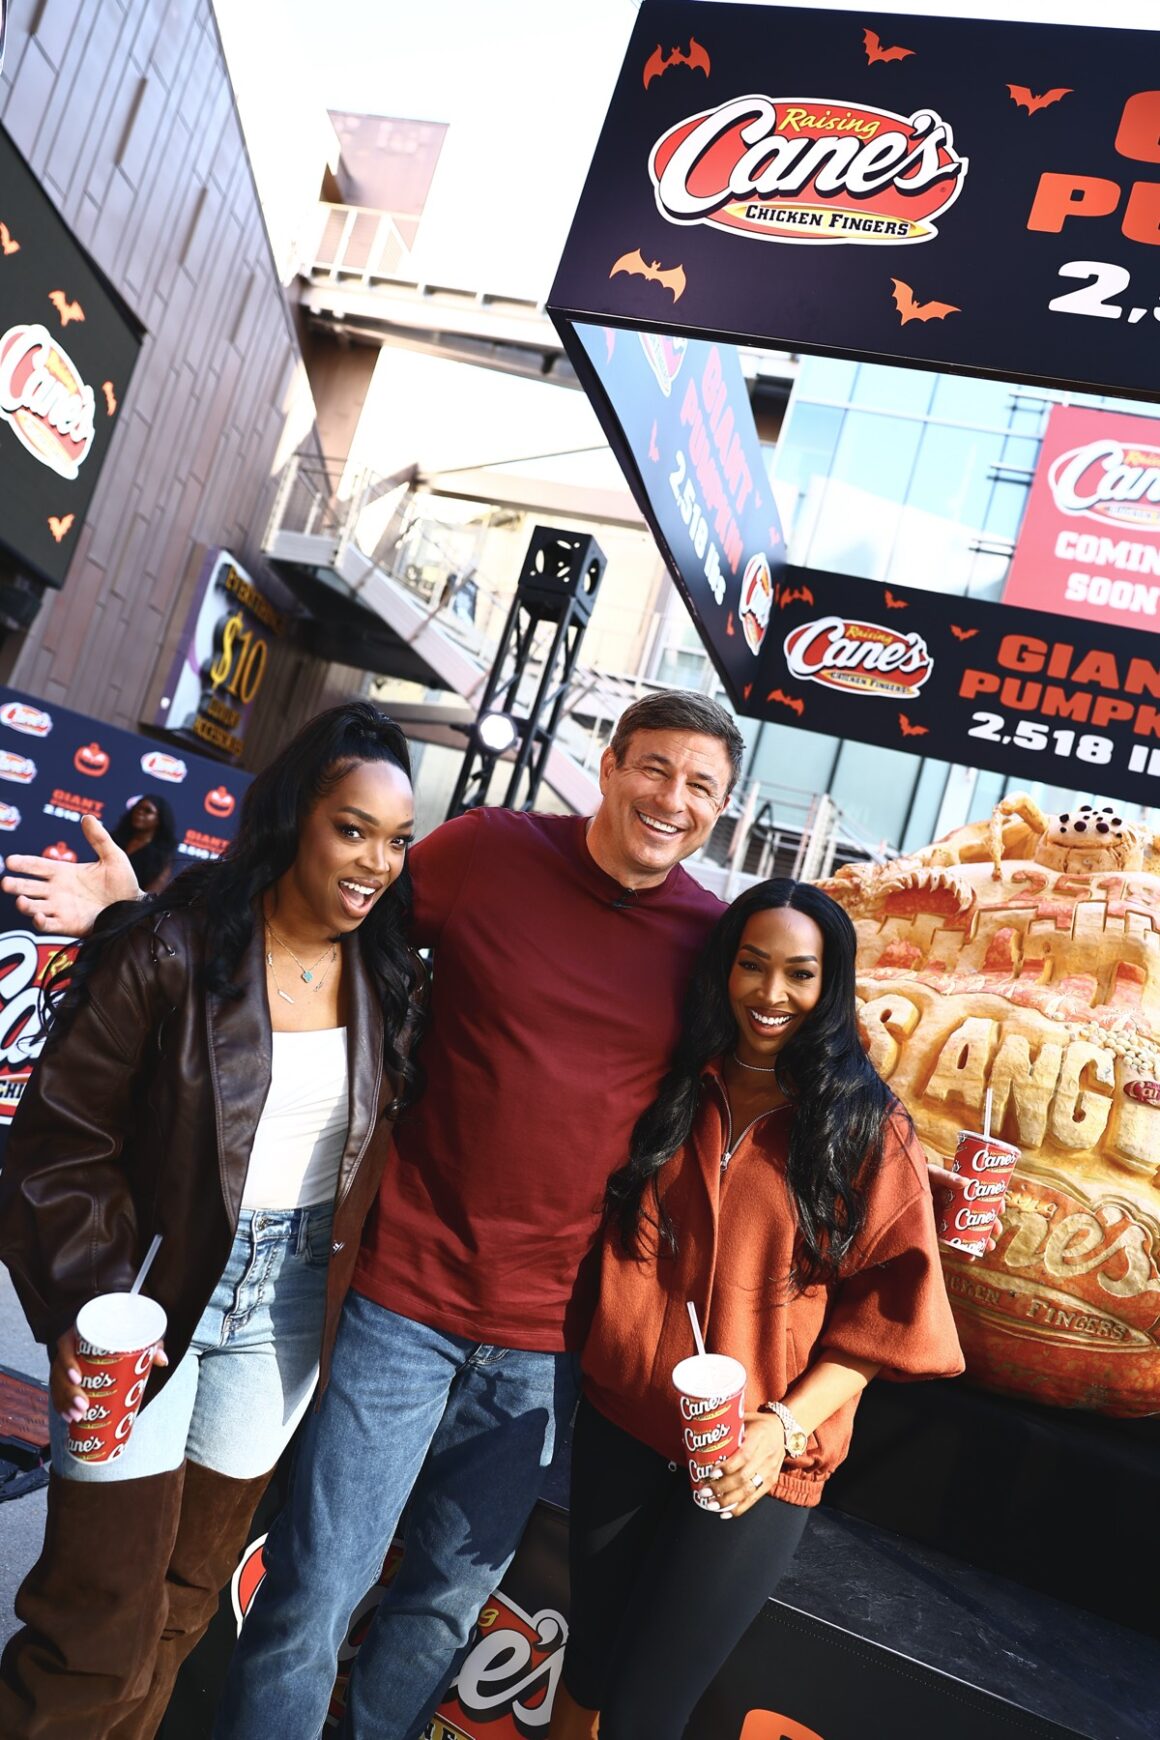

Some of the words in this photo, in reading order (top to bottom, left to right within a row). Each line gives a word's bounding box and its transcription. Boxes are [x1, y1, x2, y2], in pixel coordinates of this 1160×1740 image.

[779, 107, 880, 138] Raising
[658, 98, 960, 215] Cane's
[745, 203, 823, 228] CHICKEN
[828, 213, 910, 238] FINGERS
[1064, 572, 1160, 616] SOON
[210, 610, 268, 704] $10
[789, 616, 930, 675] Cane's
[967, 711, 1114, 765] 2,518
[1025, 1299, 1129, 1341] FINGERS
[684, 1423, 731, 1452] Cane's
